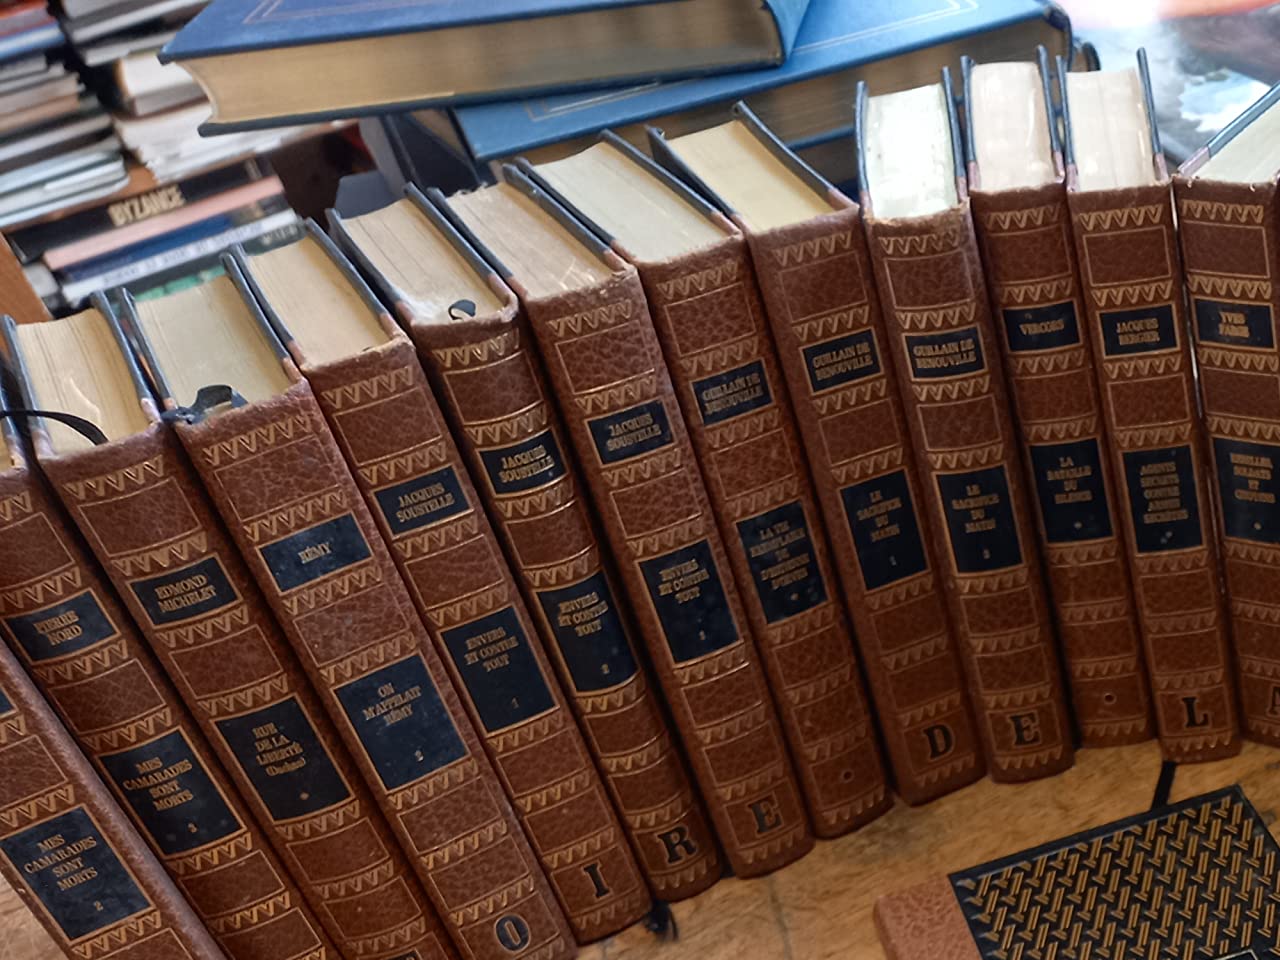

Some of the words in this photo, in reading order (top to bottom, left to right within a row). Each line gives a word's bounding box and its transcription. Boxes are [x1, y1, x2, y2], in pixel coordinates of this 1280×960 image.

[107, 185, 186, 228] BYZANCE
[1116, 318, 1160, 334] JACQUES
[1219, 311, 1246, 324] YVES
[607, 412, 653, 437] JACQUES
[605, 423, 662, 451] SOUSTELLE
[501, 444, 547, 470] JACQUES
[498, 456, 555, 483] SOUSTELLE
[398, 482, 446, 508] JACQUES
[395, 494, 456, 523] SOUSTELLE
[760, 527, 774, 541] LA
[297, 541, 332, 564] RÉMY
[154, 574, 208, 599] EDMOND
[158, 585, 217, 614] MICHELET
[558, 591, 600, 613] ENVERS
[34, 611, 79, 635] PIERRE
[558, 612, 573, 627] ET
[574, 618, 602, 637] TOUT
[50, 625, 83, 646] NORD
[464, 626, 507, 650] ENVERS
[464, 650, 479, 665] ET
[480, 636, 520, 658] CONTRE
[482, 653, 511, 672] TOUT
[377, 682, 395, 698] ON
[1180, 696, 1209, 729] L
[1009, 712, 1041, 747] E
[255, 739, 271, 752] DE
[271, 734, 291, 748] LA
[923, 723, 954, 761] D
[122, 759, 193, 790] CAMARADES
[136, 757, 163, 774] MES
[149, 780, 181, 798] SONT
[153, 790, 194, 811] MORTS
[749, 796, 784, 836] E
[24, 836, 97, 874] CAMARADES
[37, 834, 65, 853] MES
[657, 825, 699, 865] R
[52, 857, 84, 878] SONT
[57, 867, 98, 890] MORTS
[582, 862, 610, 899] I
[493, 913, 532, 953] O
